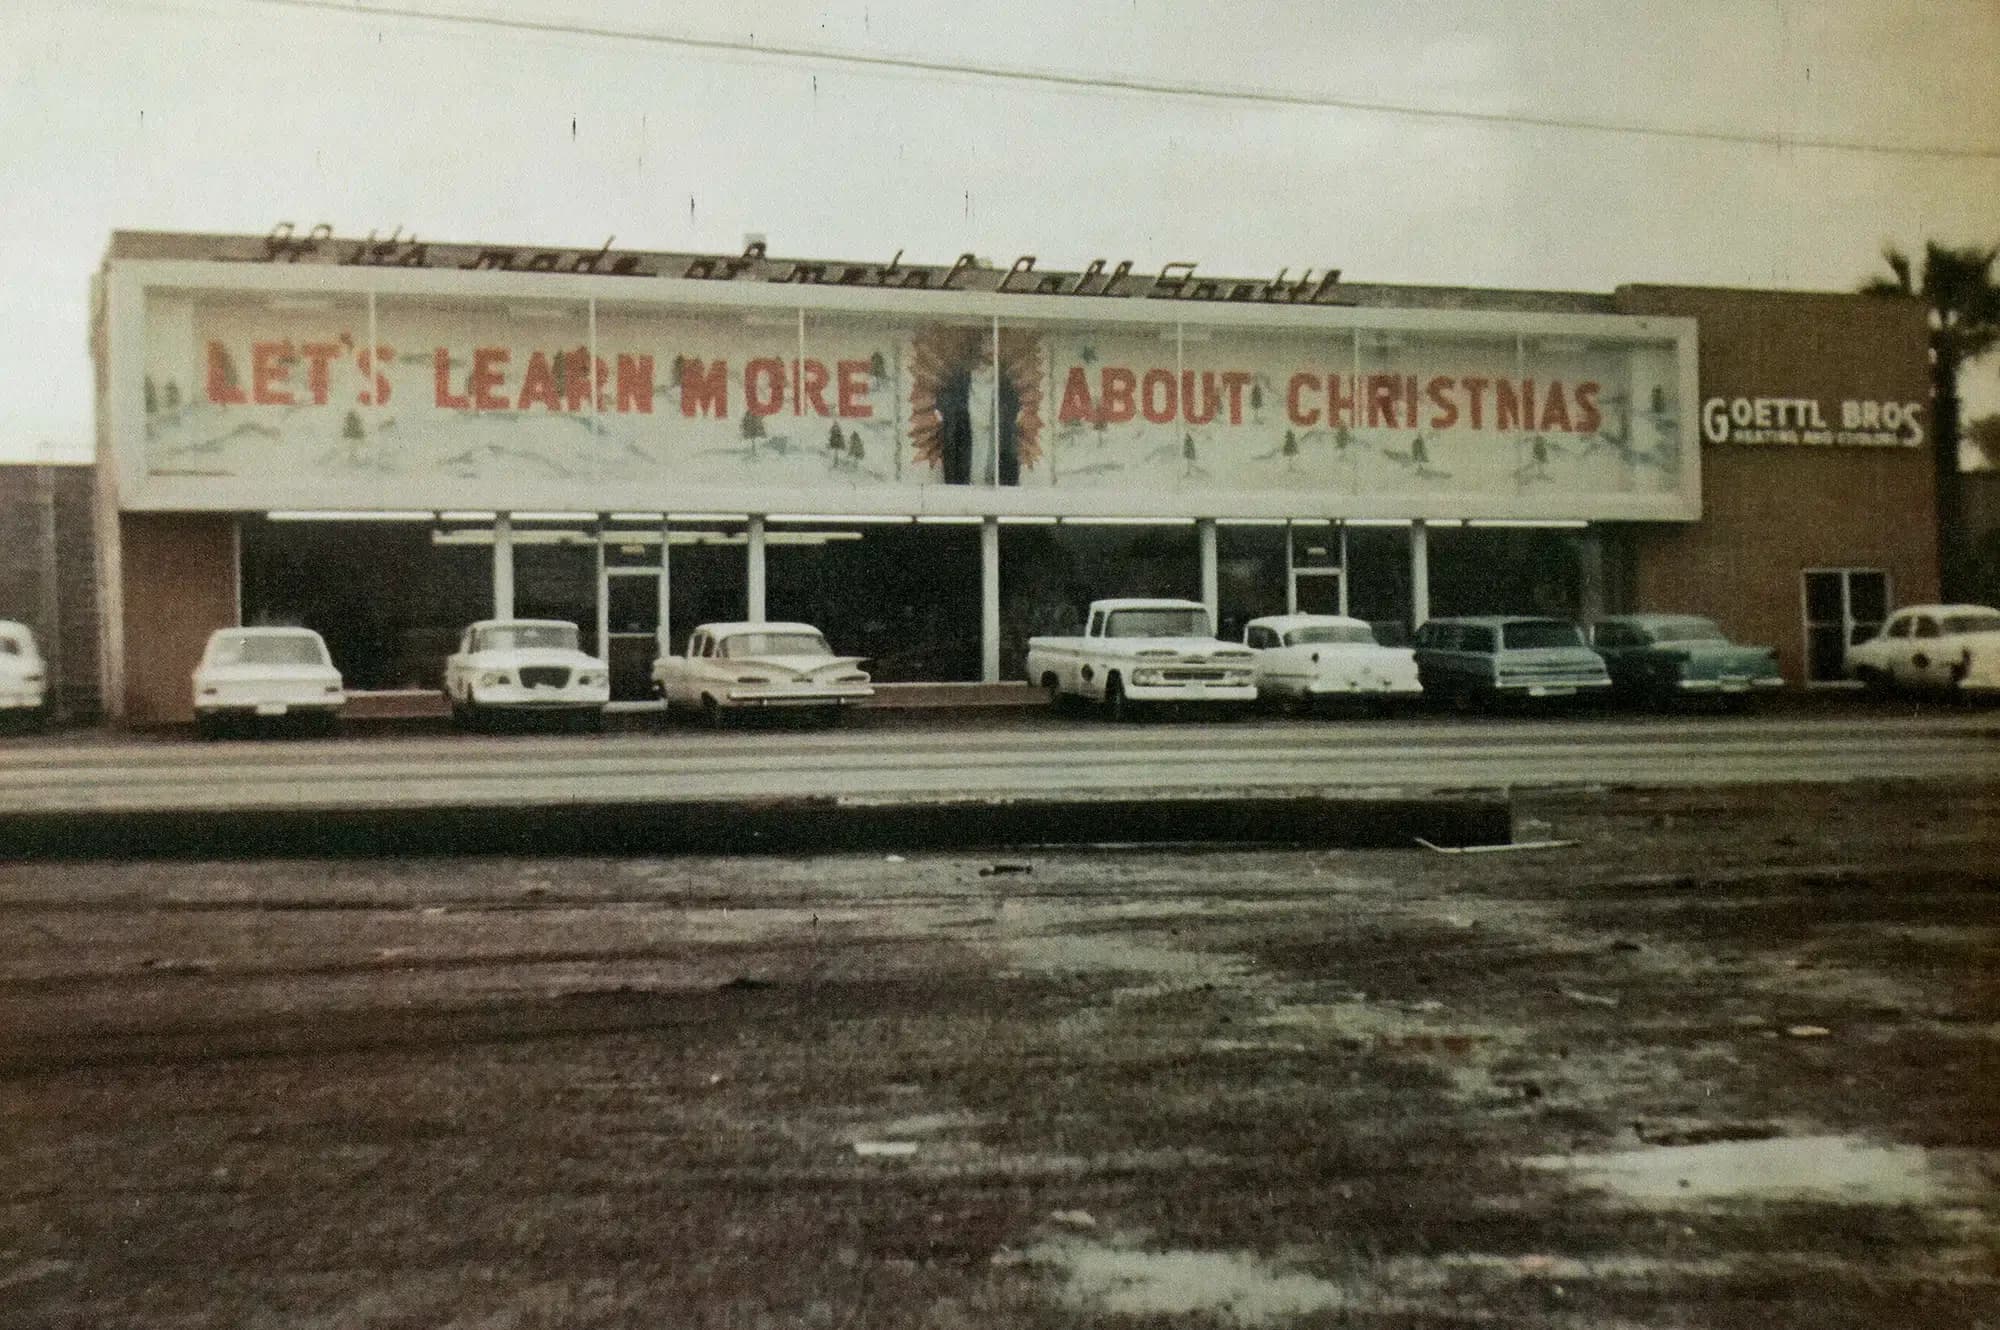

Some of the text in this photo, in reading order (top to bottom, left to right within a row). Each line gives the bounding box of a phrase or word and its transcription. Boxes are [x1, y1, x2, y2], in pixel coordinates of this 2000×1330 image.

[459, 235, 656, 277] made
[768, 249, 965, 290] metal
[996, 255, 1132, 297] Call
[207, 328, 1602, 433] LET'S LEARN MORE ABOUT CHRISTMAS
[1703, 397, 1924, 448] GOETTL BROS
